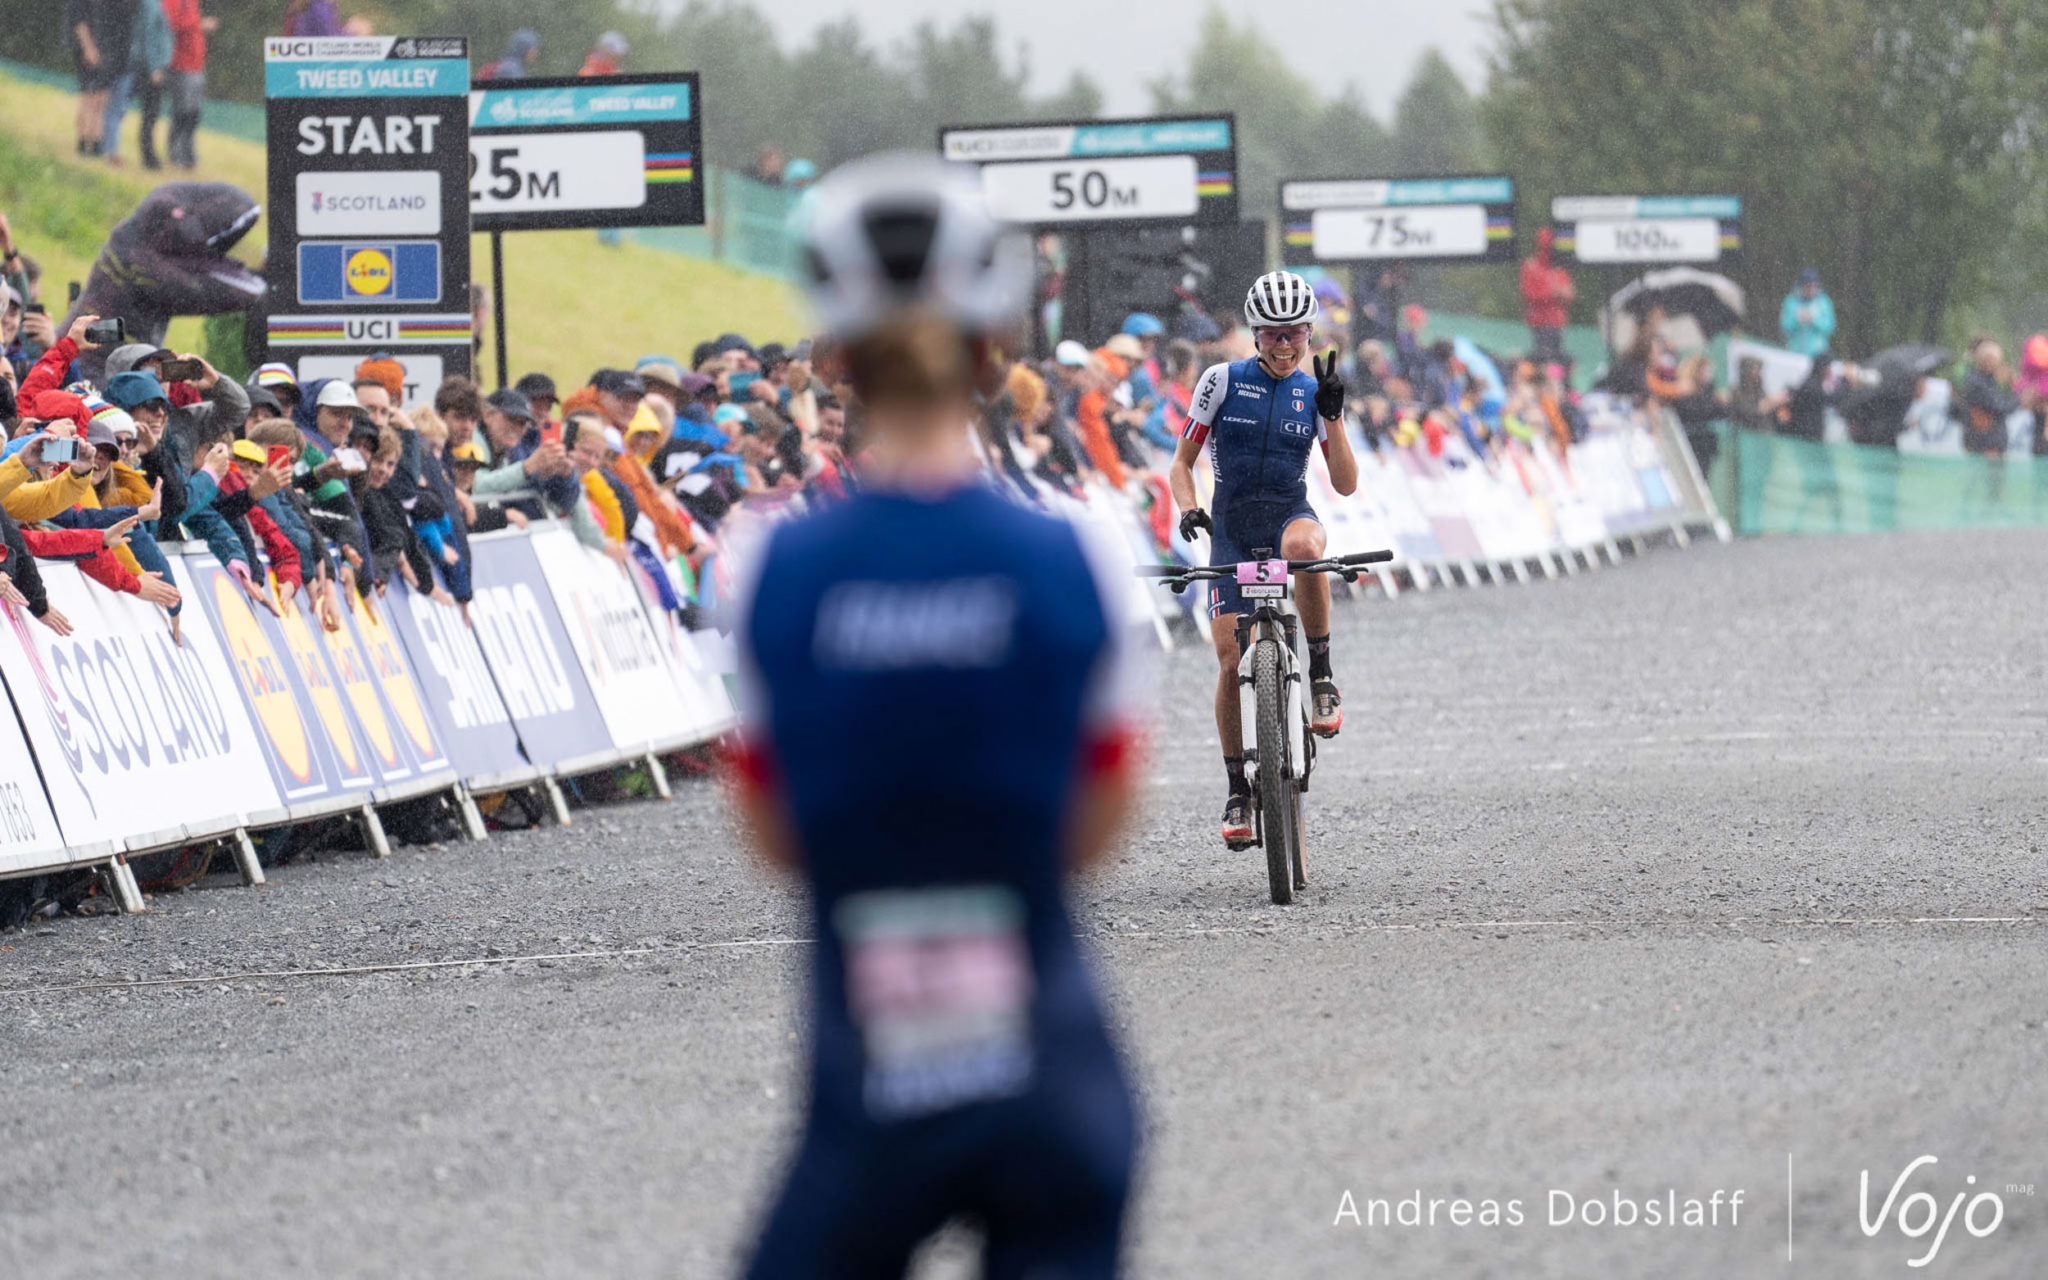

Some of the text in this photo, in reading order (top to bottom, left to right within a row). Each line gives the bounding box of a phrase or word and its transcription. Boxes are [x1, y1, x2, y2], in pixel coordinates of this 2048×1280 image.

[278, 43, 313, 56] UCI
[296, 68, 438, 89] TWEED VALLEY
[296, 115, 441, 155] START
[1052, 170, 1139, 209] 50M
[327, 195, 426, 211] SCOTLAND
[1364, 216, 1432, 247] 75M
[347, 320, 392, 340] UCI
[1198, 372, 1217, 411] SKF
[1234, 382, 1268, 394] CANYON
[1222, 415, 1259, 425] LOOK
[1284, 422, 1311, 436] CIC
[1210, 437, 1223, 483] FRANCE
[1255, 562, 1270, 582] 5
[51, 631, 231, 775] SCOLAND
